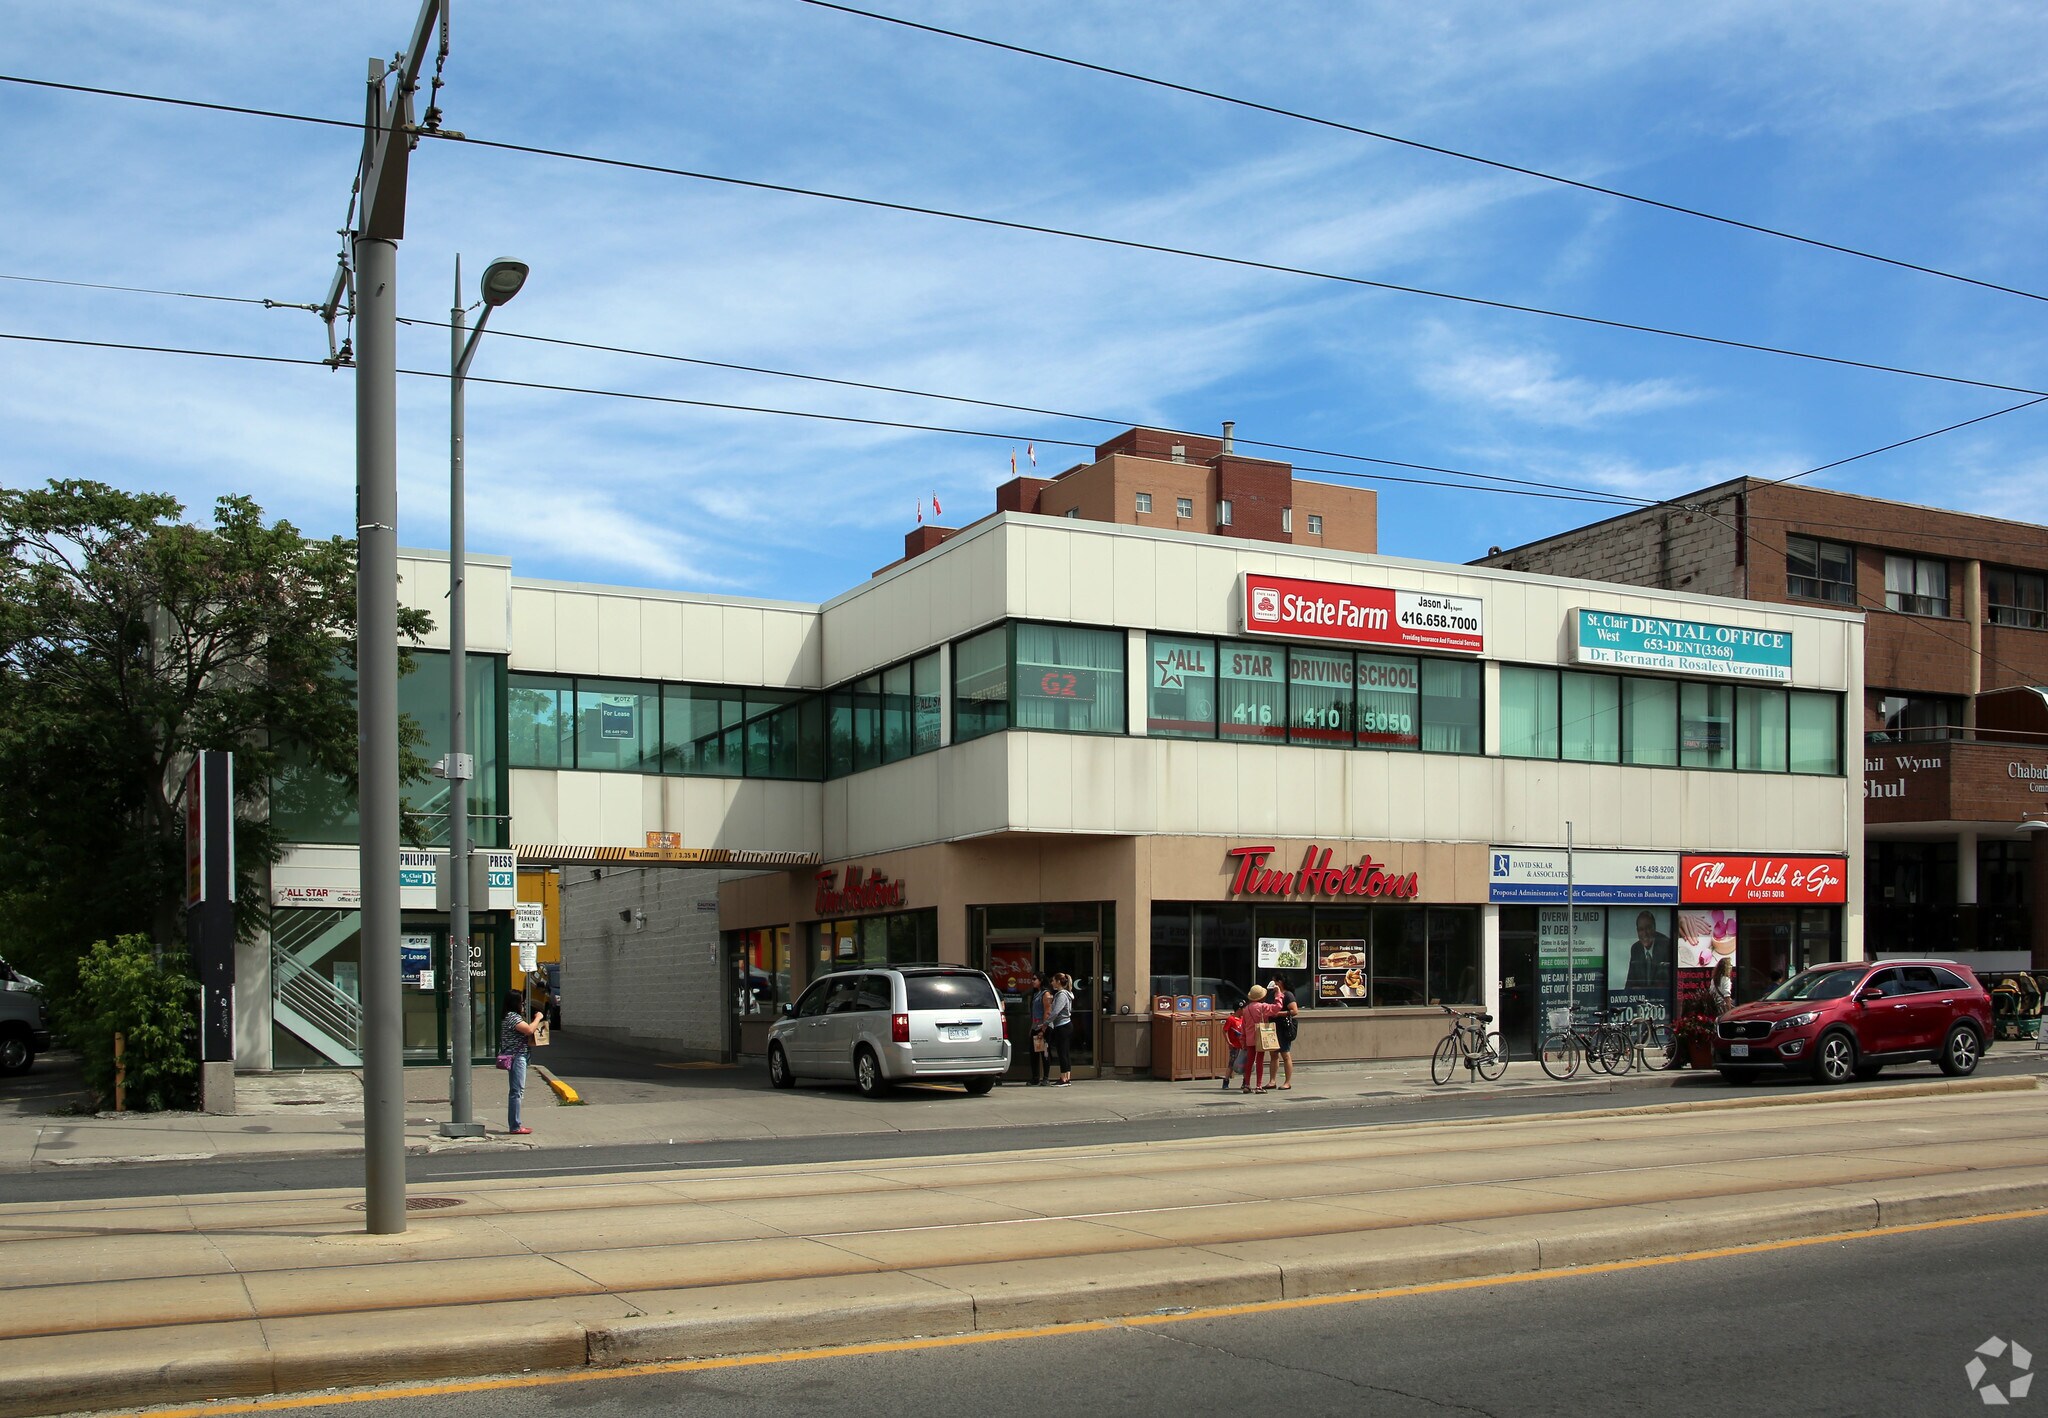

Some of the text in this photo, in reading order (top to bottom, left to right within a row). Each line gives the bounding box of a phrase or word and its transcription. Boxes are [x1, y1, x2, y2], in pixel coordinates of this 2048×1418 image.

[1418, 596, 1441, 608] Jason
[1401, 611, 1477, 631] 416.658.7000
[1587, 613, 1629, 629] St. Clair
[1402, 633, 1420, 643] Providing
[1420, 635, 1439, 643] Insurance
[1447, 637, 1464, 645] Financial
[1464, 639, 1481, 647] Services
[1596, 628, 1620, 642] West
[1630, 617, 1783, 649] DENTAL OFFICE
[1643, 638, 1734, 660] 653-DENT(3368)
[1175, 649, 1417, 689] ALL STAR DRIVING SCHOOL
[1590, 648, 1785, 678] Dr. Bernarda Rosales Verzonilla
[1041, 673, 1077, 697] G2
[1233, 702, 1412, 732] 416 410 5050
[1864, 756, 1942, 773] hil Wynn
[2008, 762, 2048, 779] Chabad
[400, 853, 513, 868] PHILIPPIN PRESS
[629, 850, 660, 858] Maximum
[1231, 844, 1418, 898] Tim Hortons
[1513, 861, 1532, 869] DAVID
[1634, 865, 1675, 874] 416-498-9200
[1689, 860, 1839, 897] Tiffany Nails & Spa
[287, 889, 328, 897] ALL STAR
[815, 865, 902, 915] Tim Hortons
[1492, 888, 1517, 897] Proposal
[1518, 889, 1559, 897] Administrators
[1581, 890, 1612, 898] Counsellors
[1644, 891, 1674, 900] Bankruptcy
[1747, 890, 1761, 899] (416)
[1762, 890, 1771, 898] 551
[1541, 911, 1600, 922] OVERWELMED
[1541, 925, 1578, 935] BY DEB?
[468, 946, 482, 958] 50
[470, 960, 483, 968] lair
[1541, 974, 1551, 982] WE
[1552, 973, 1565, 982] CAN
[1583, 973, 1596, 982] YOU
[1678, 970, 1704, 978] Manicure
[1541, 985, 1553, 994] GET
[1553, 985, 1566, 993] OUT
[1576, 984, 1595, 993] DEBT!
[1610, 995, 1629, 1003] DAVID
[1629, 995, 1646, 1003] SKLAR
